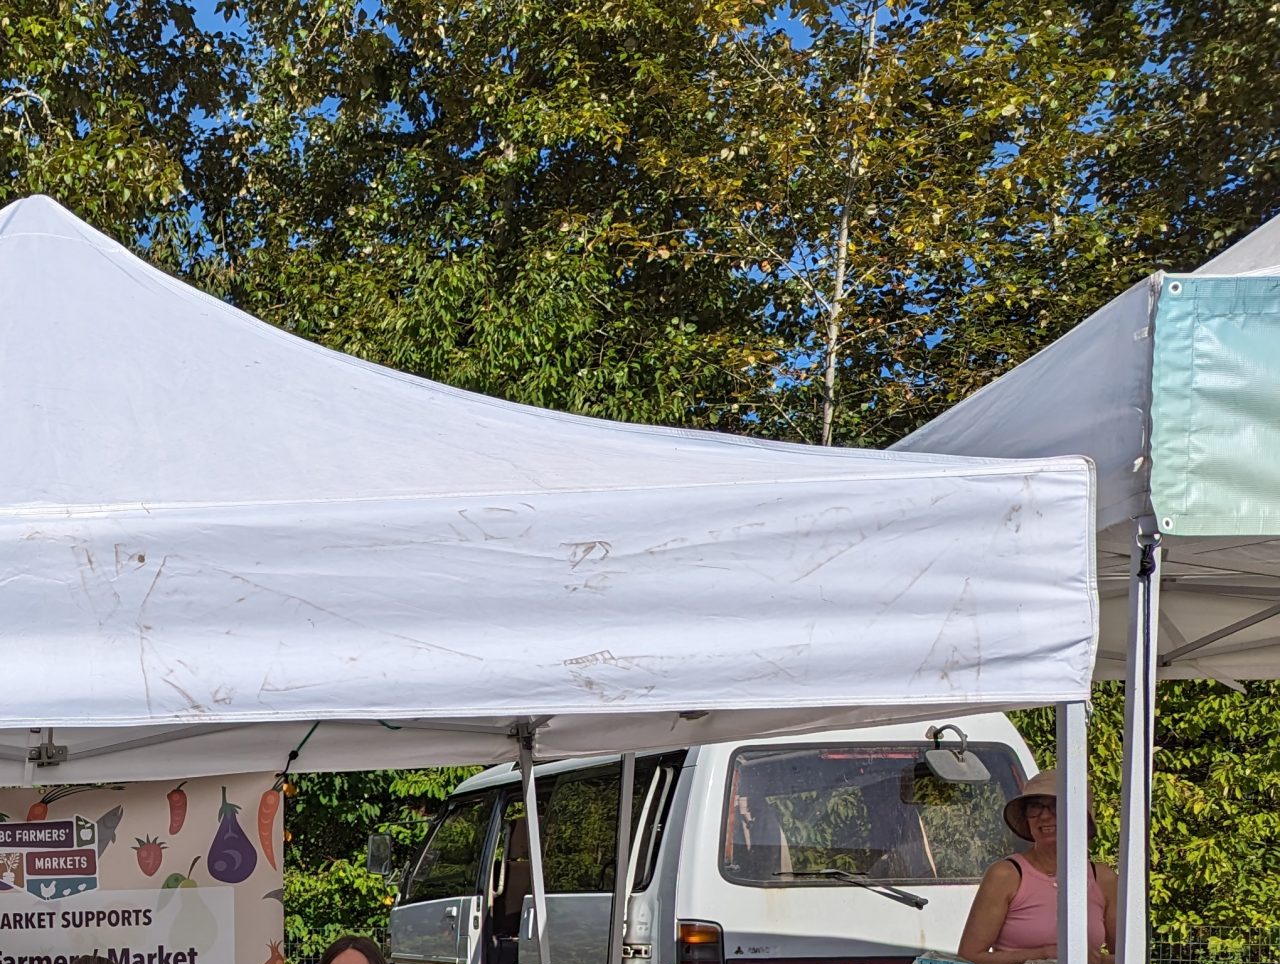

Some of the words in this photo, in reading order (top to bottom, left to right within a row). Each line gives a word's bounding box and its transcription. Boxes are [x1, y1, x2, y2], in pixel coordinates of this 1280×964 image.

[16, 828, 70, 842] FARMERS'
[34, 856, 88, 870] MARKETS
[61, 908, 153, 928] SUPPORTS
